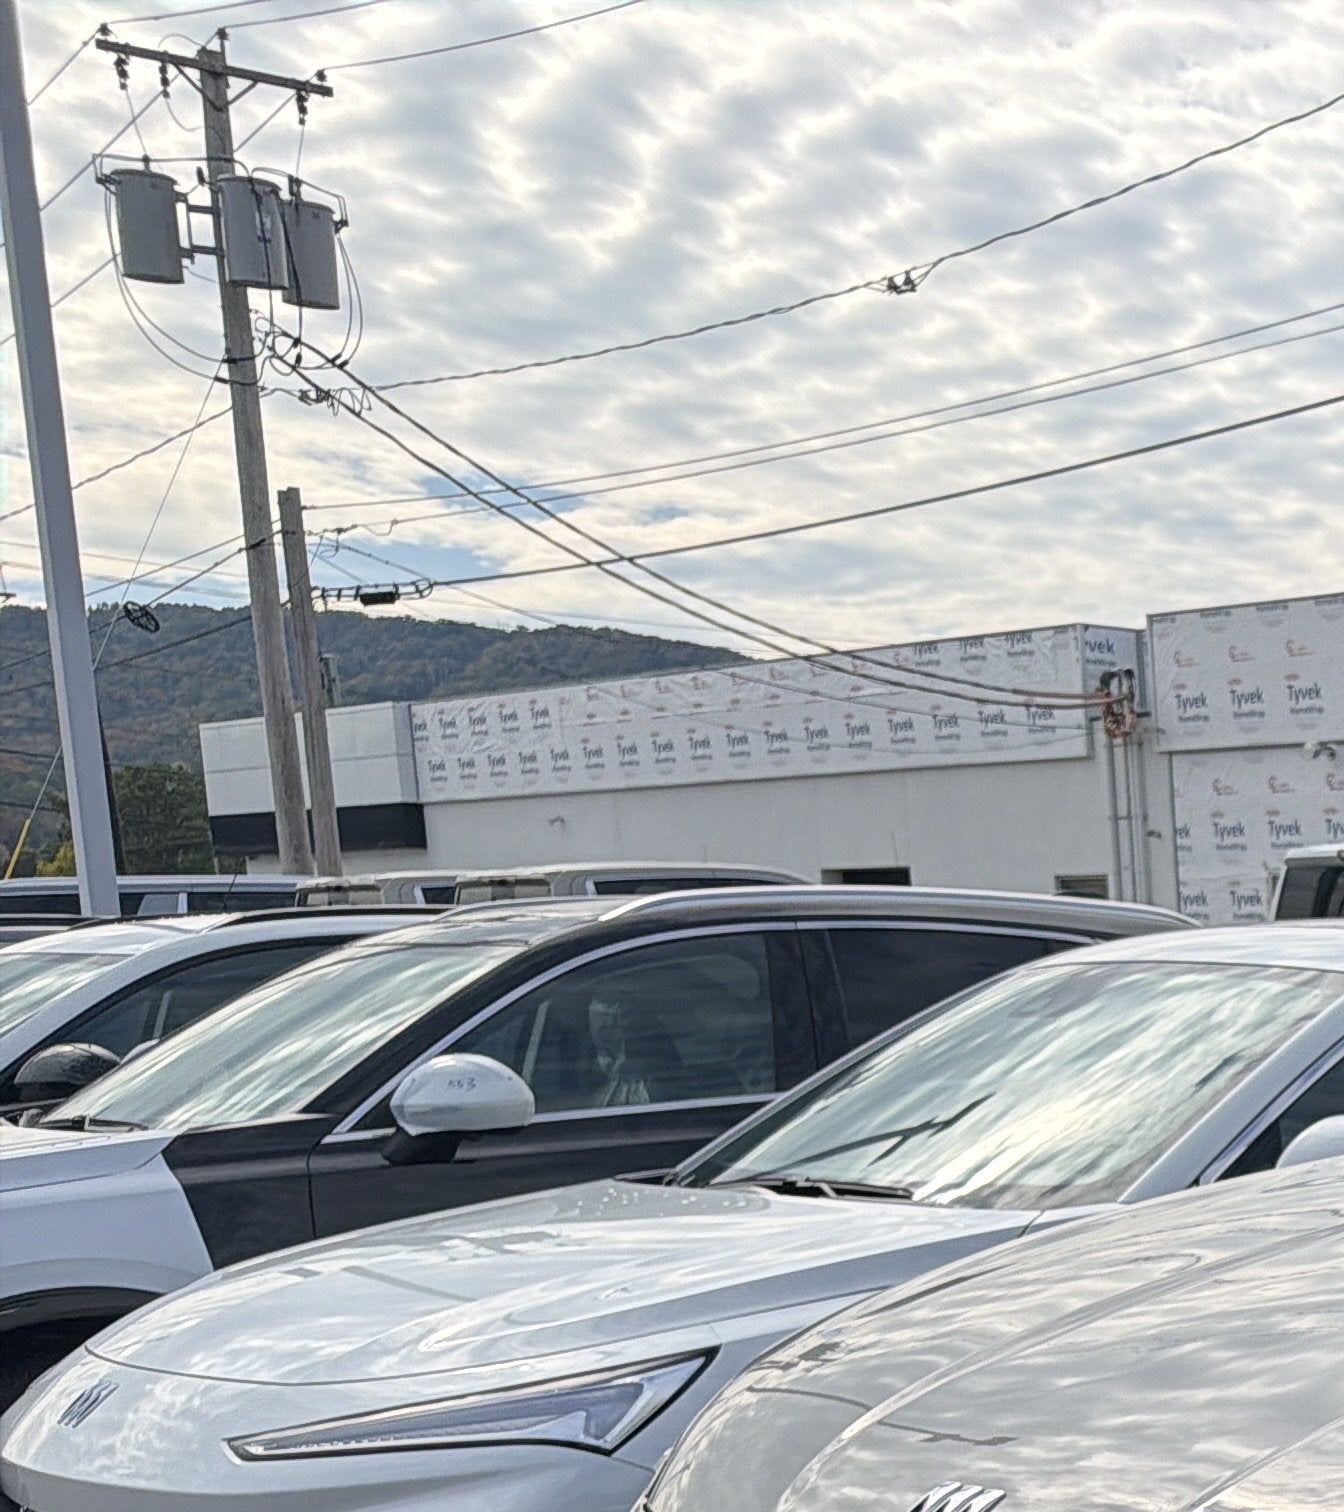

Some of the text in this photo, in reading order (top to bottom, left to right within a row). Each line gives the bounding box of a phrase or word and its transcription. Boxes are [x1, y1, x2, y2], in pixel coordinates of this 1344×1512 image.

[1175, 693, 1208, 712] Tyvek
[1229, 689, 1263, 708] Tyvek
[1287, 684, 1322, 704] Tyvek
[1213, 822, 1245, 841] Tyvek
[1268, 820, 1301, 839] Tyvek
[1230, 888, 1262, 910] Tyvek
